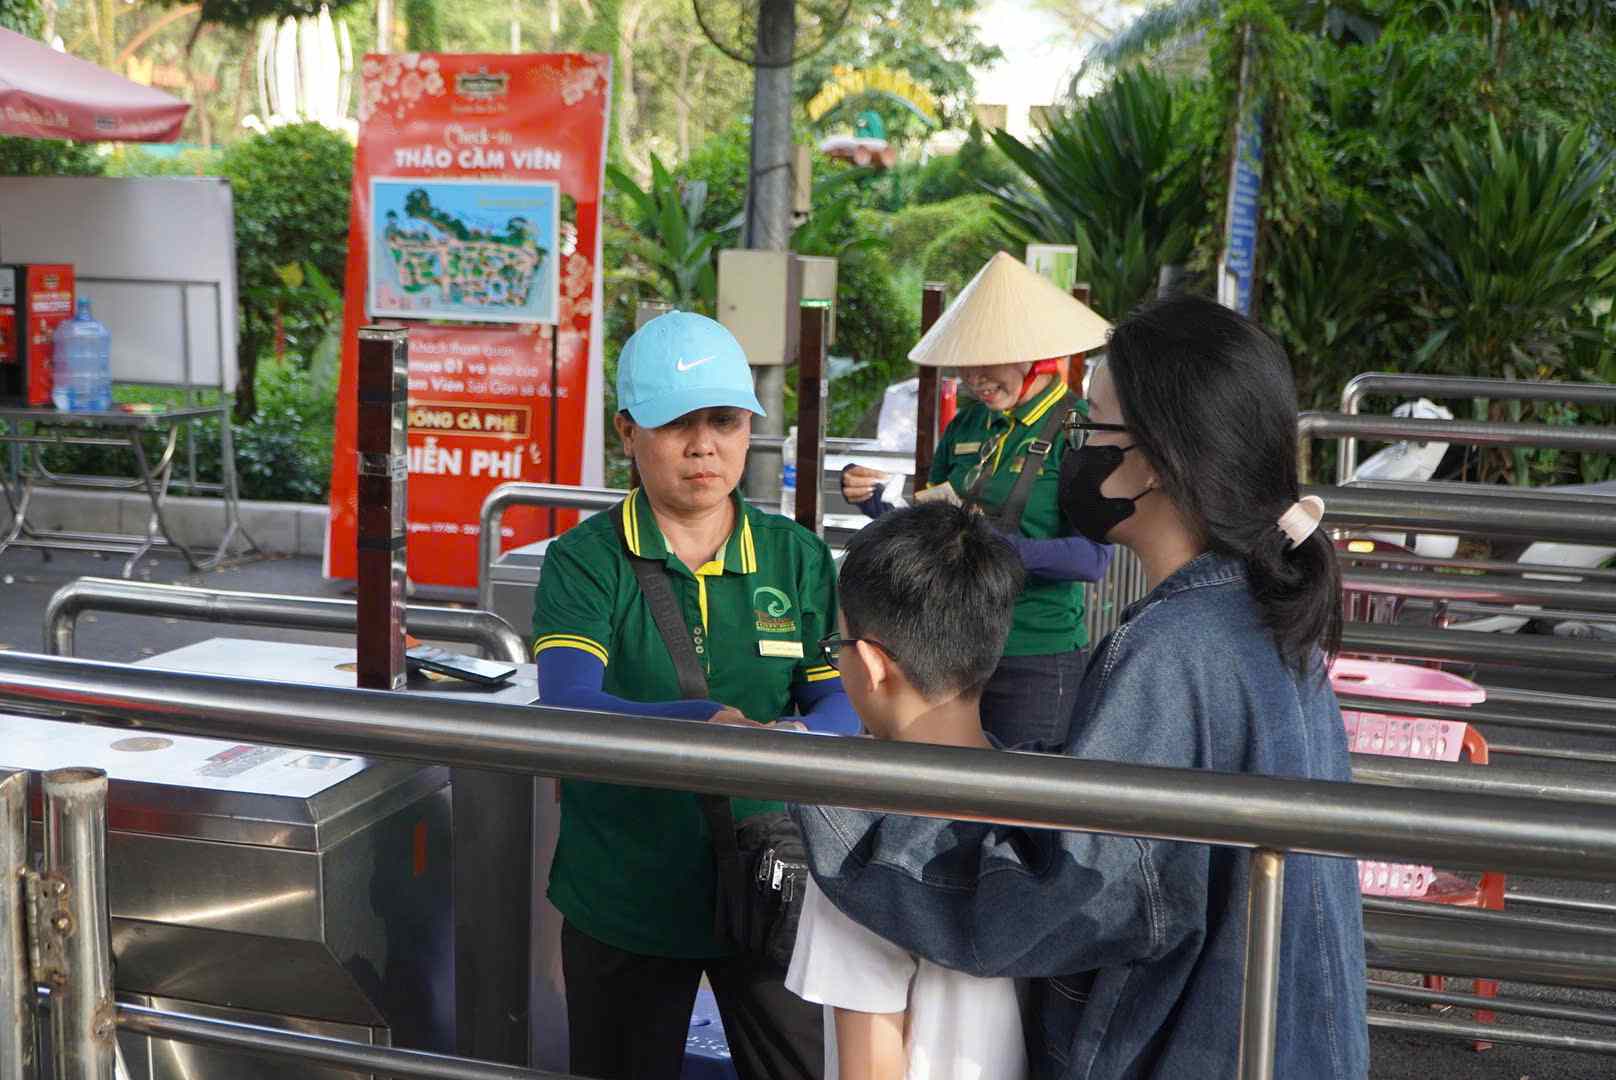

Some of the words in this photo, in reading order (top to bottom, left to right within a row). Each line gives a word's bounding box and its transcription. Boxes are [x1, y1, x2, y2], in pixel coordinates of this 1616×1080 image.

[394, 145, 453, 169] THẢO
[457, 145, 506, 170] CẦM
[510, 147, 562, 171] VIÊN
[470, 444, 525, 480] PHÍ
